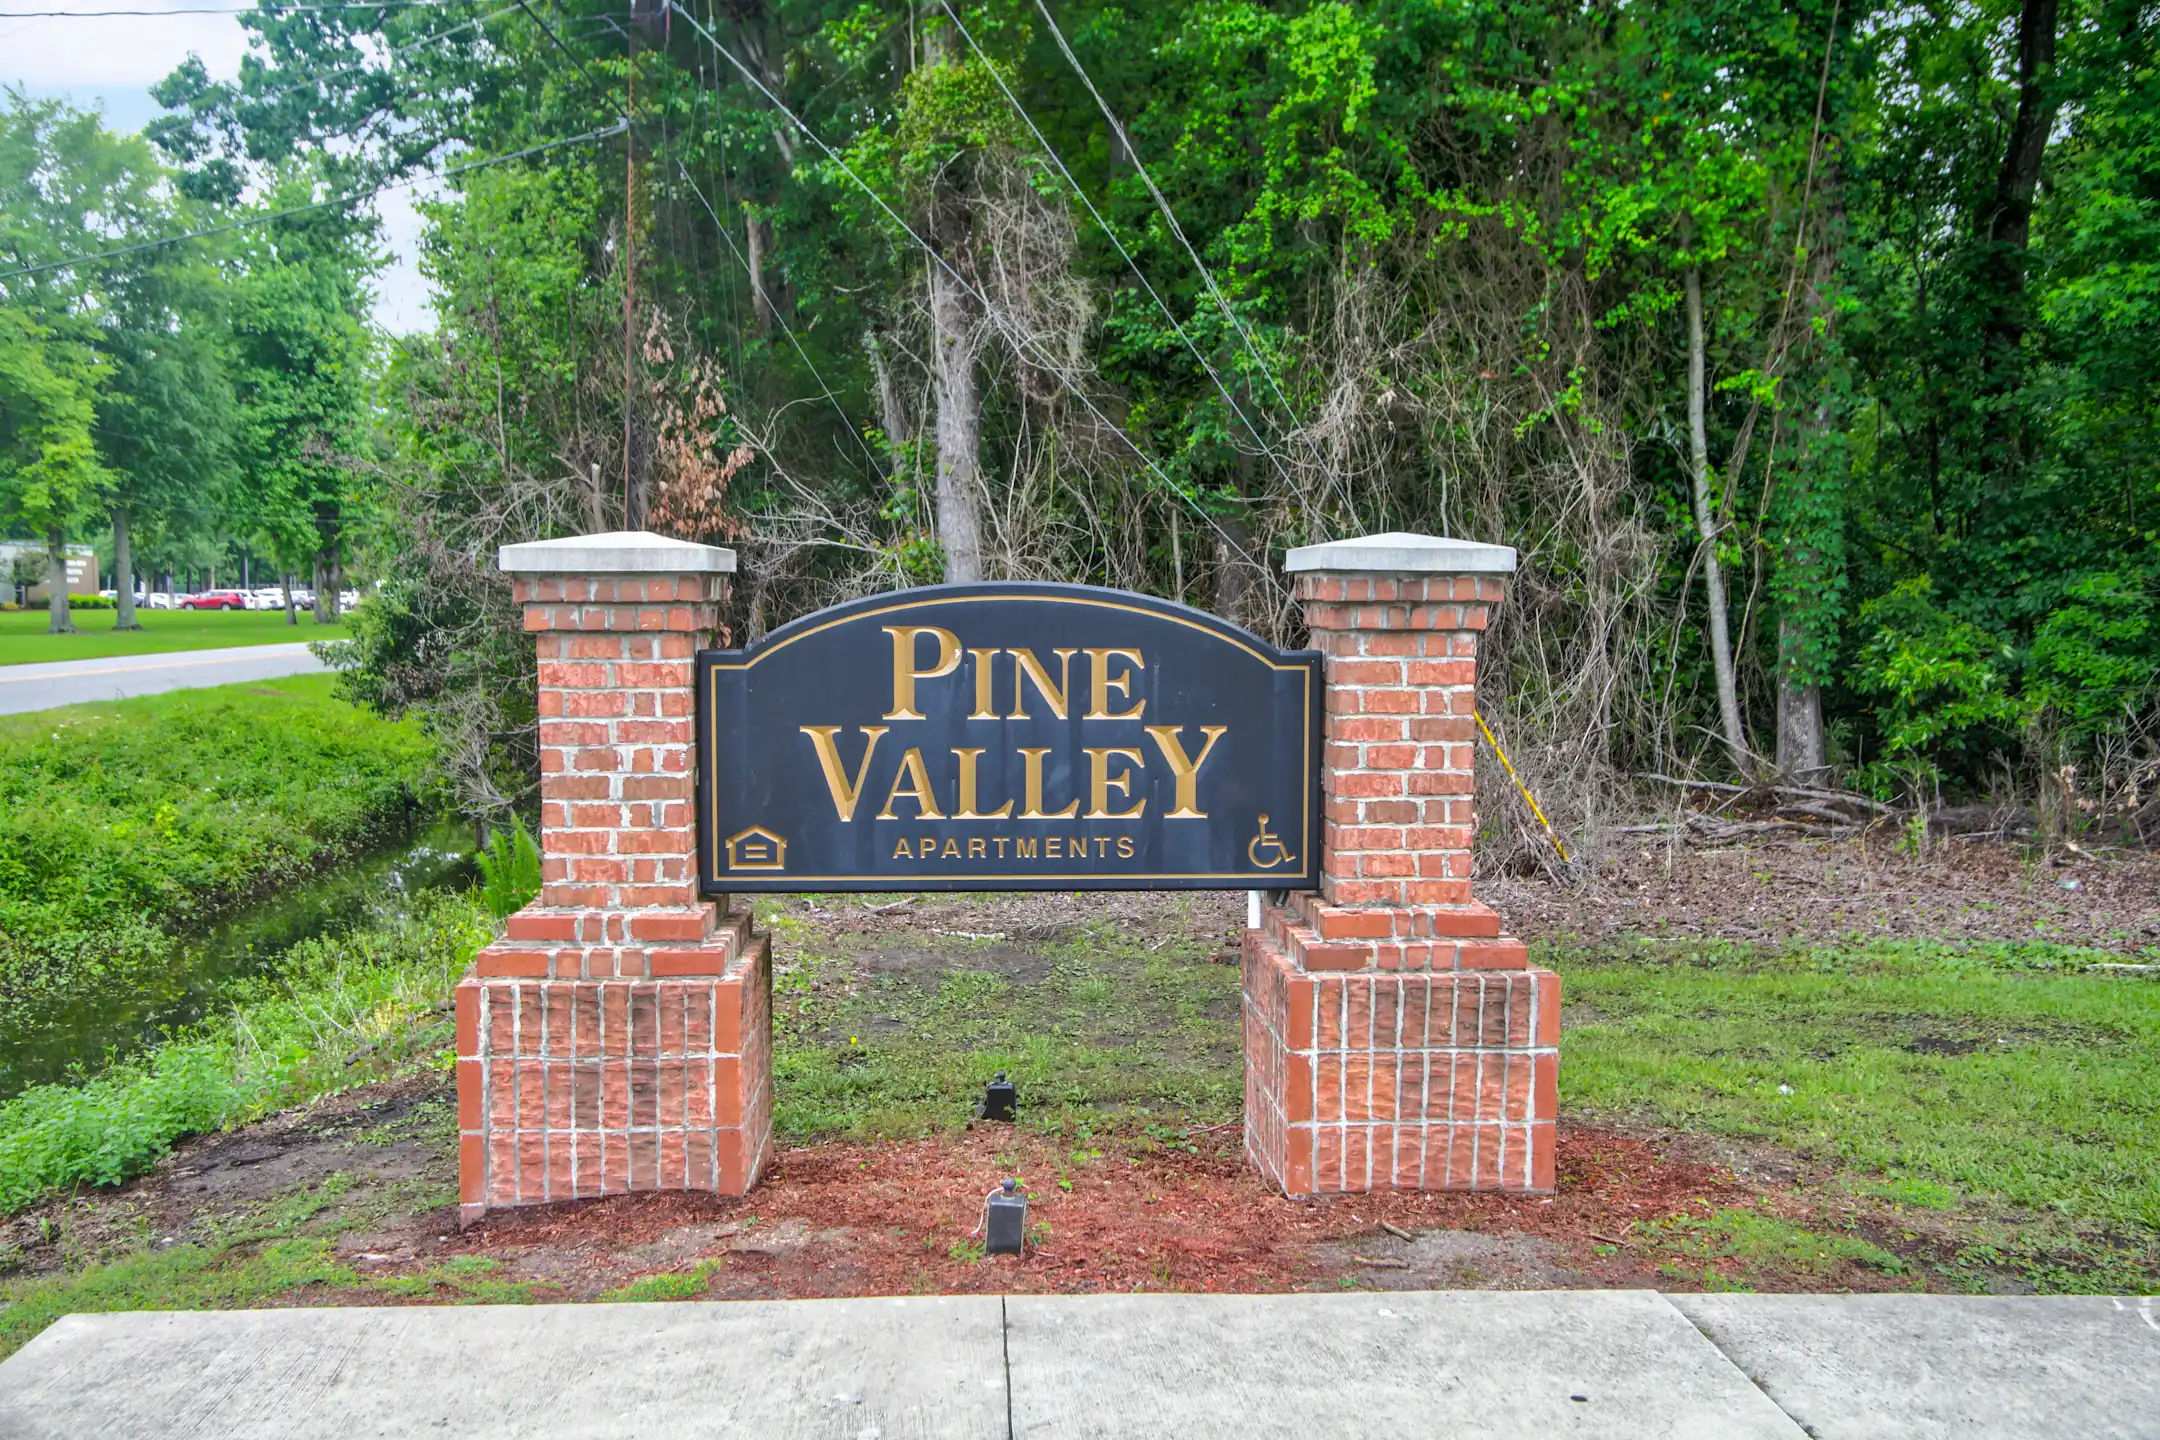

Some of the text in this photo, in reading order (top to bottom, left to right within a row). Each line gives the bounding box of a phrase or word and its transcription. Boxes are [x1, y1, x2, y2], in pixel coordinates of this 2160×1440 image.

[882, 625, 1147, 720] PINE
[799, 725, 1227, 822] VALLEY
[892, 836, 1136, 859] APARTMENTS
